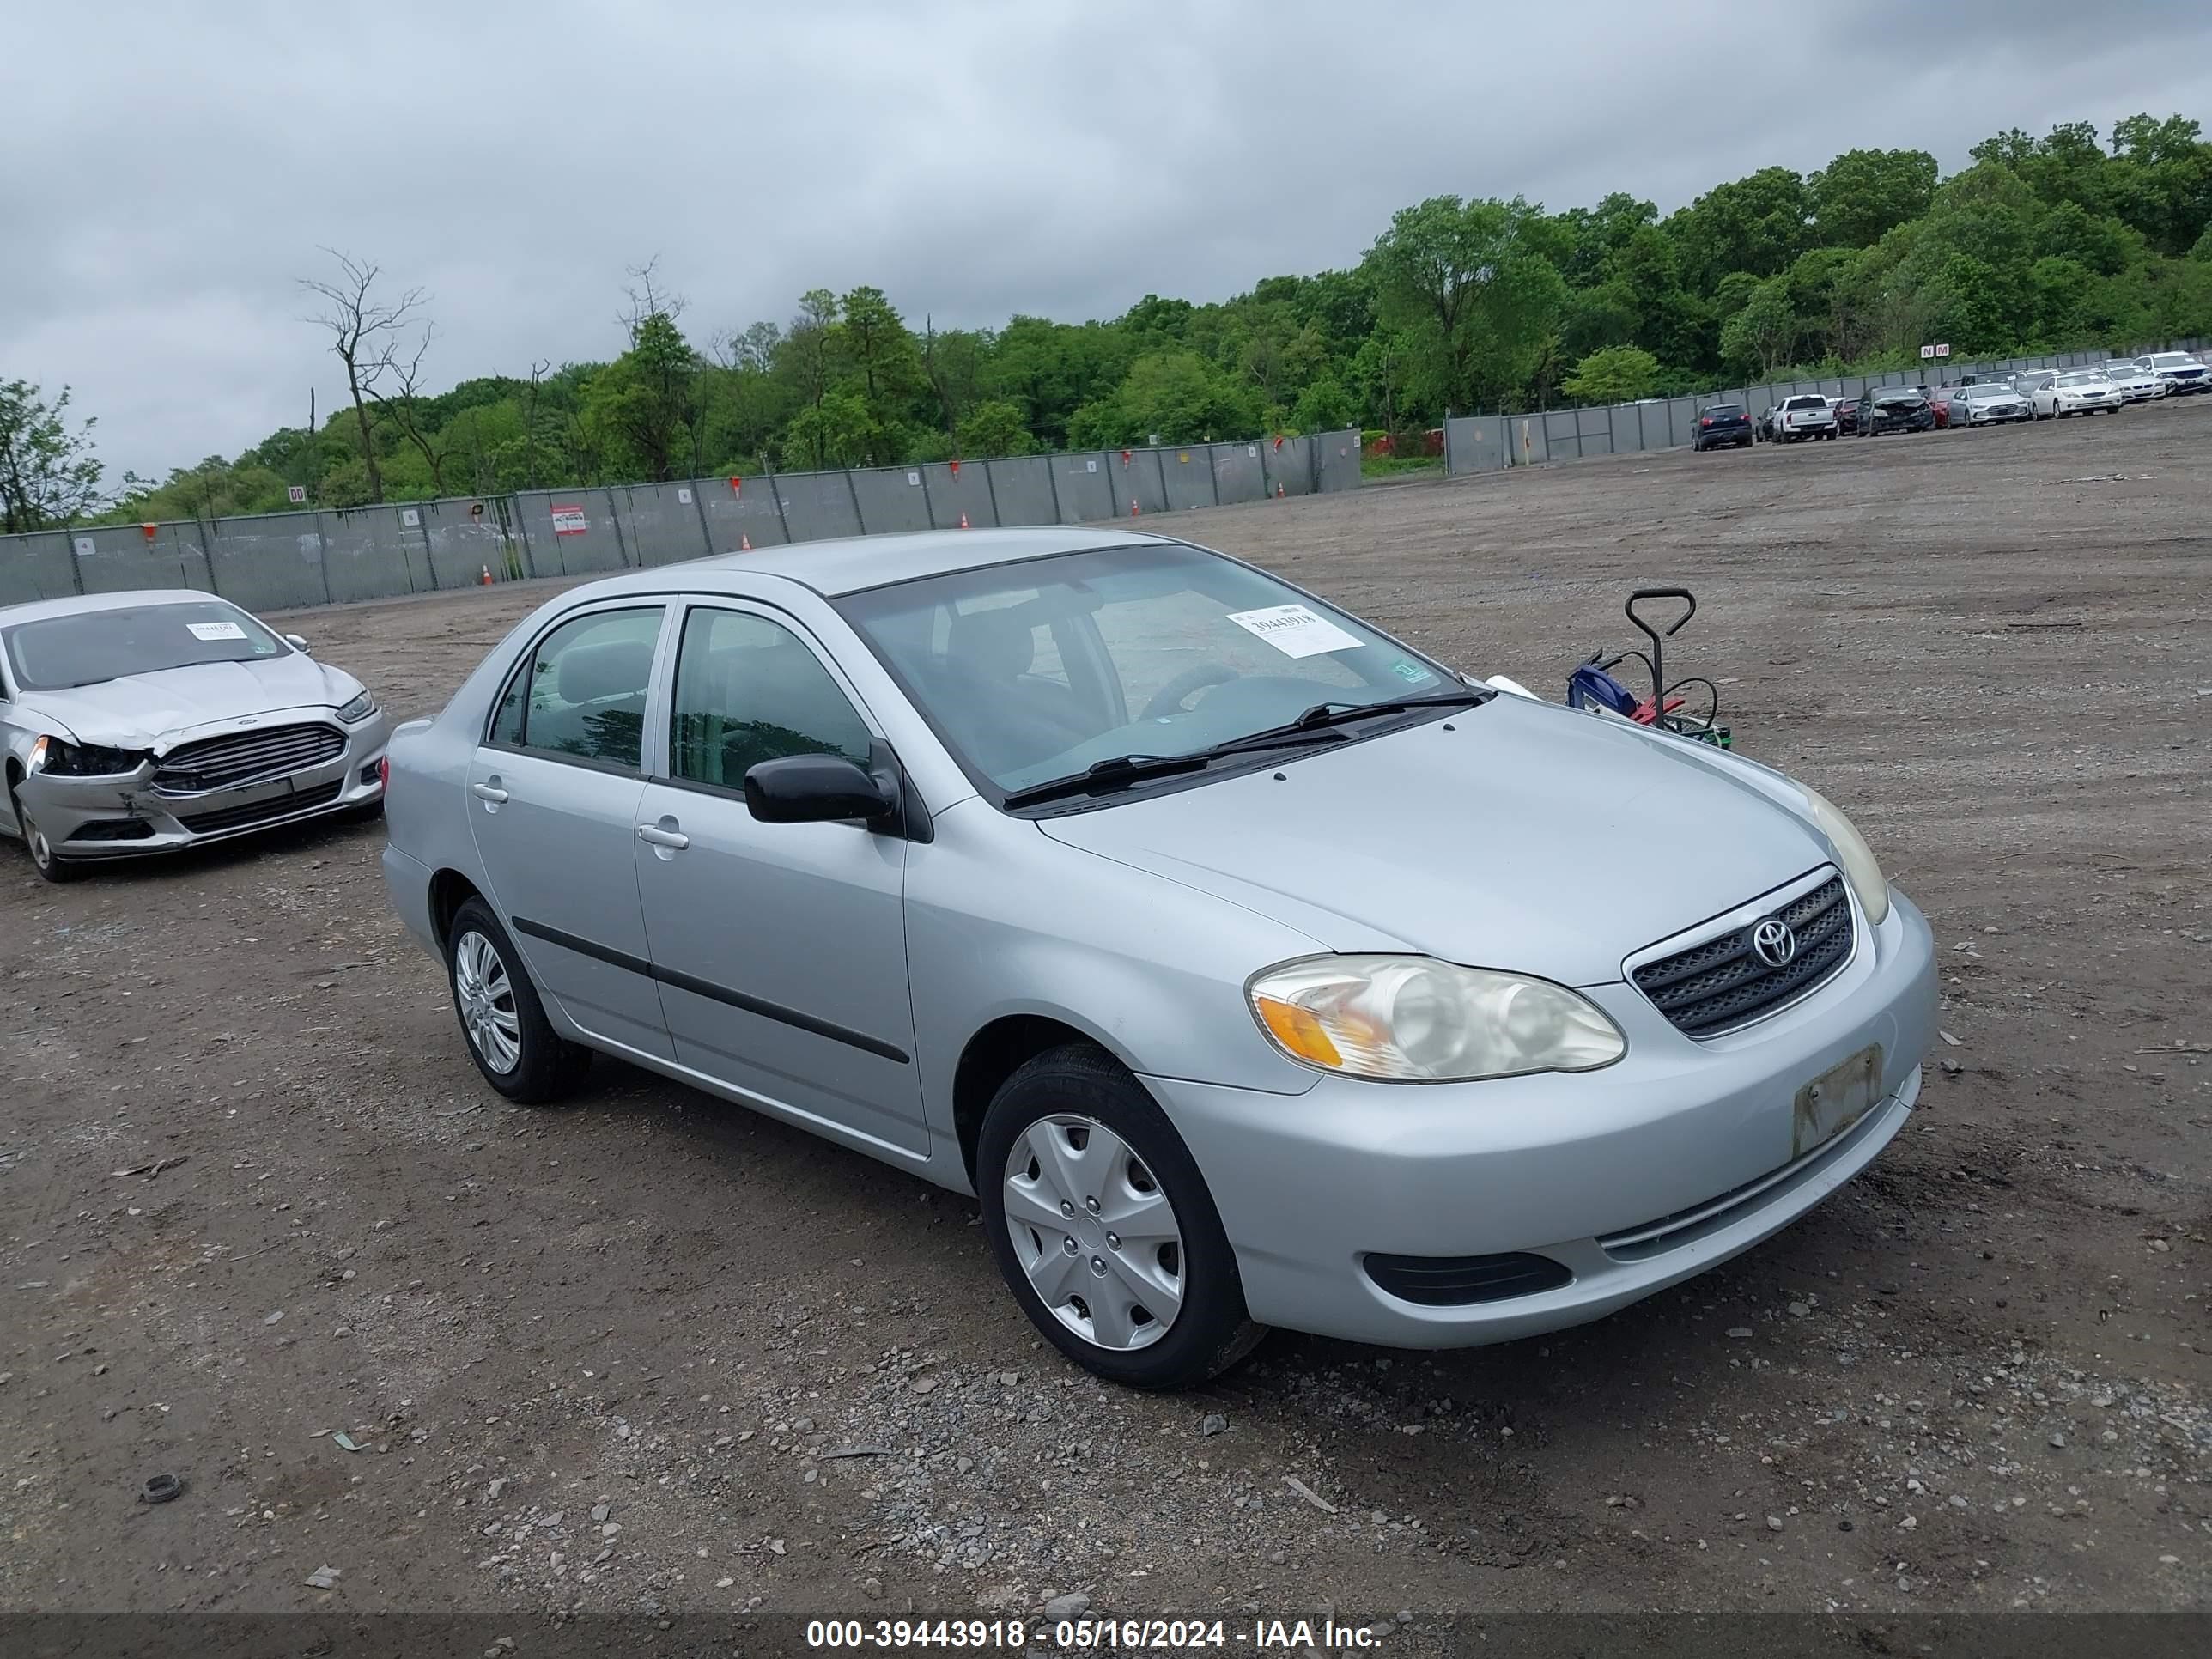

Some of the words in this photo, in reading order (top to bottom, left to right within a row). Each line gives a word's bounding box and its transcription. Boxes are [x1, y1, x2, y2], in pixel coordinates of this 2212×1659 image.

[1923, 347, 1931, 356] N
[1937, 346, 1948, 355] M
[290, 489, 303, 501] DD
[1251, 614, 1316, 632] 39443918
